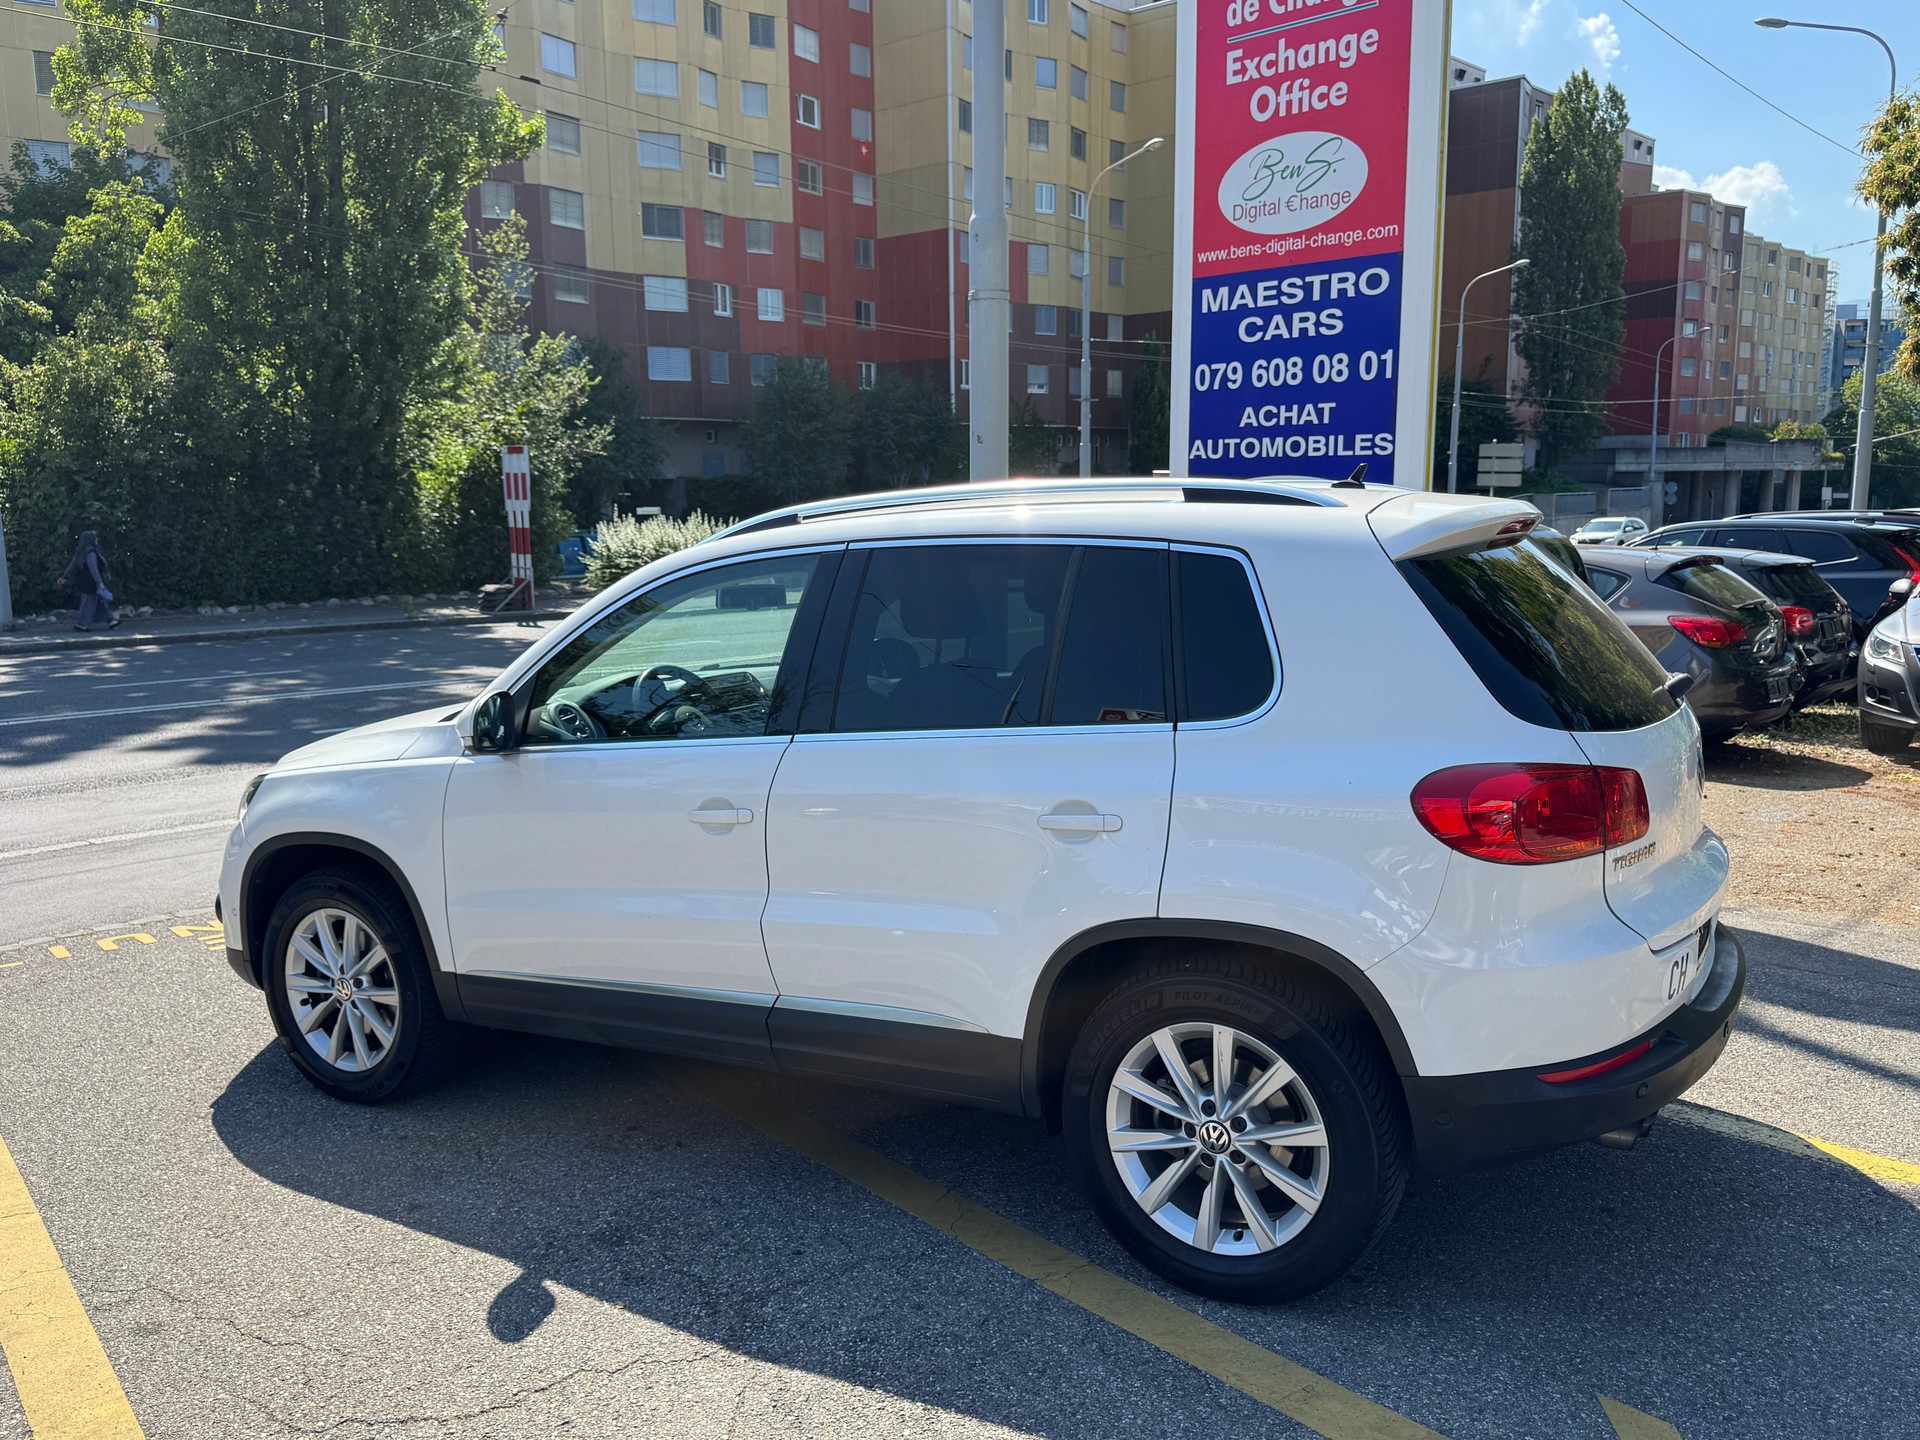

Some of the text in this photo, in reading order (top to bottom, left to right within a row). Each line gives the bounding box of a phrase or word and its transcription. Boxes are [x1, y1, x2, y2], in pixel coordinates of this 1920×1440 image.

[1226, 0, 1260, 27] de
[1225, 28, 1379, 85] Exchange
[1249, 78, 1349, 122] Office
[1233, 197, 1281, 223] Digital
[1197, 224, 1399, 263] www.bens-digital-change.com
[1201, 267, 1390, 313] MAESTRO
[1238, 308, 1344, 343] CARS
[1194, 348, 1394, 391] 079 608 08 01
[1239, 402, 1336, 428] ACHAT
[1189, 433, 1394, 460] AUTOMOBILES
[1668, 951, 1689, 1000] CH
[1174, 990, 1210, 1002] PILOT
